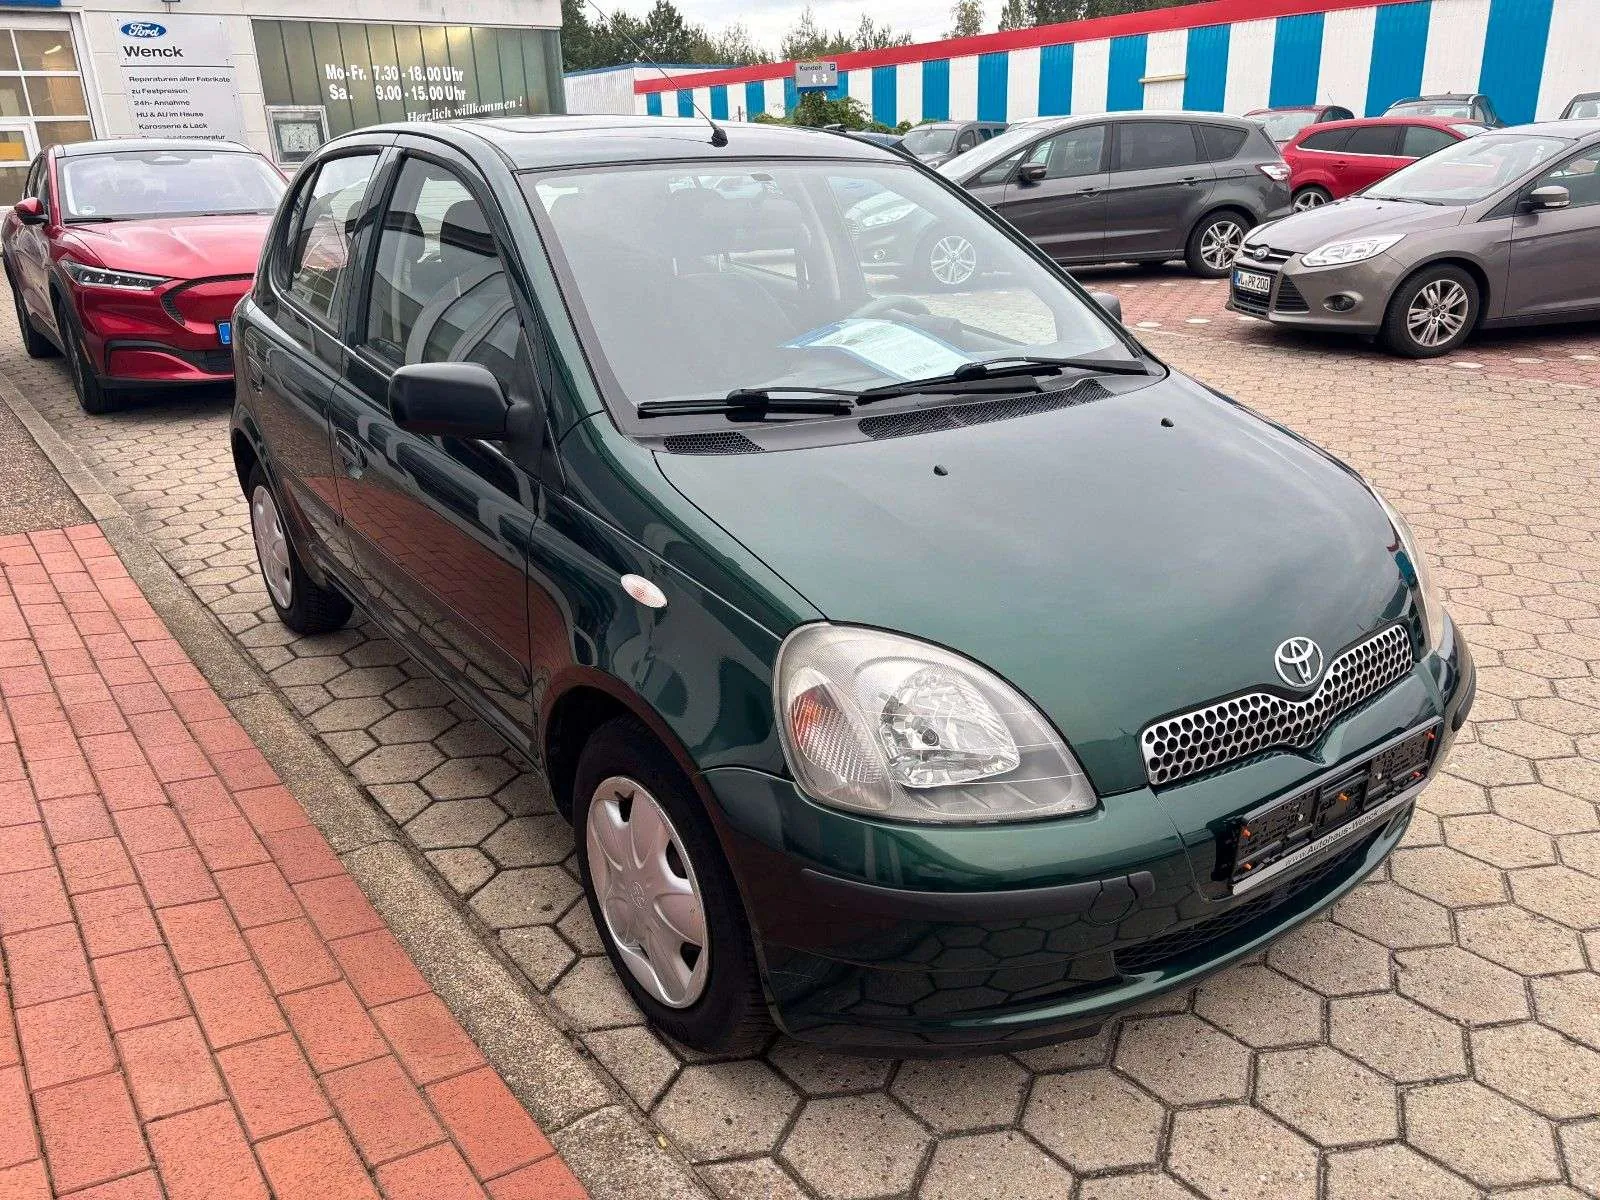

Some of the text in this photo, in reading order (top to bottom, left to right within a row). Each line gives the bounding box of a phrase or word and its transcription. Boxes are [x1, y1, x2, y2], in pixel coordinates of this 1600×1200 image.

[129, 23, 160, 38] Ford
[123, 45, 184, 58] Wenck
[373, 65, 398, 81] 7.30
[408, 66, 441, 82] 18.00
[443, 66, 464, 82] Uhr
[375, 85, 401, 101] 9.00
[411, 86, 444, 101] 15.00
[445, 86, 467, 101] Uhr
[407, 108, 451, 123] Herzlich
[454, 100, 516, 117] willkommen
[1256, 277, 1269, 290] 200
